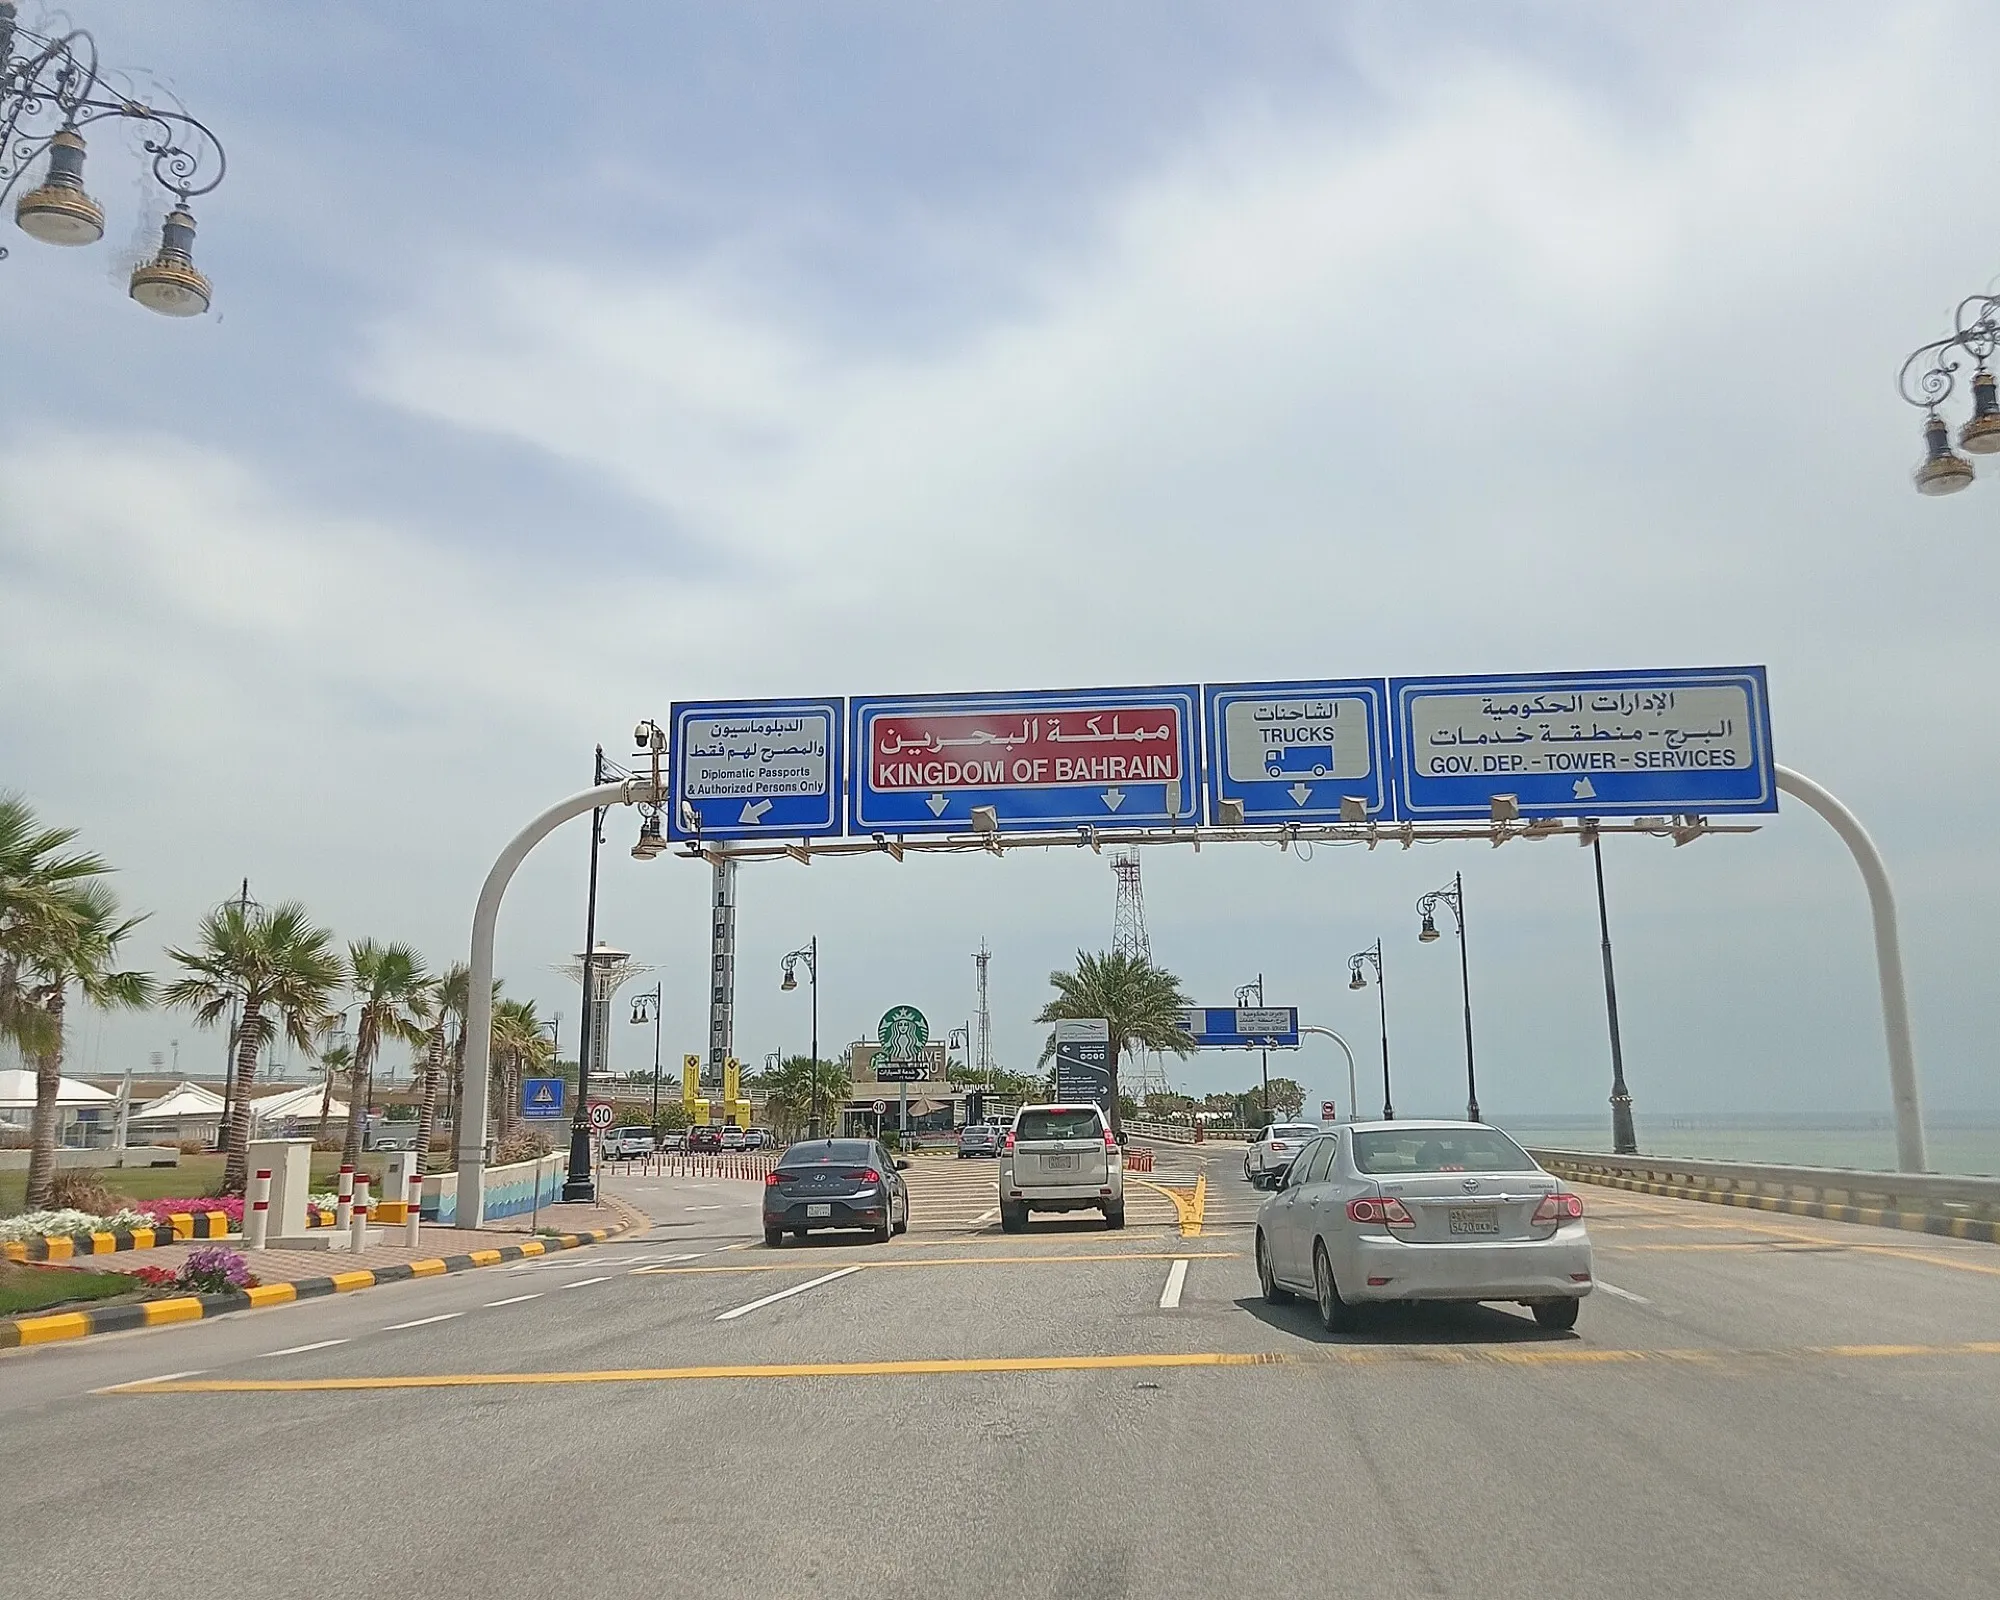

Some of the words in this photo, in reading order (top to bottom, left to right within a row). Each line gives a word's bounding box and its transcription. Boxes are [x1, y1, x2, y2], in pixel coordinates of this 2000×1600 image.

[1253, 702, 1339, 721] الشاحنات
[1482, 694, 1582, 721] الحكومية
[1591, 691, 1674, 716] الإدارات
[710, 719, 803, 738] الدبلوماسيون
[880, 717, 1039, 755] البحرين
[1046, 714, 1170, 743] مملكة
[1259, 726, 1335, 743] TRUCKS
[1430, 726, 1534, 745] خدمات
[1541, 723, 1642, 742] منطقة
[1664, 719, 1732, 749] البرج
[689, 742, 725, 757] فقط
[727, 742, 757, 762] لهم
[760, 740, 825, 762] والمصرح
[880, 760, 1005, 786] KINGDOM
[1012, 758, 1048, 783] OF
[1055, 755, 1172, 781] BAHRAIN
[1430, 756, 1478, 774] GOV.
[1483, 755, 1528, 772] DEP.
[1544, 752, 1616, 771] TOWER
[1634, 749, 1736, 768] SERVICES
[701, 768, 755, 780] Diplomatic
[759, 766, 810, 779] Passports
[687, 784, 696, 795] &
[697, 783, 753, 794] Authorized
[756, 782, 797, 793] Persons
[799, 780, 824, 792] Only
[594, 1108, 611, 1124] 30
[874, 1102, 884, 1111] 40
